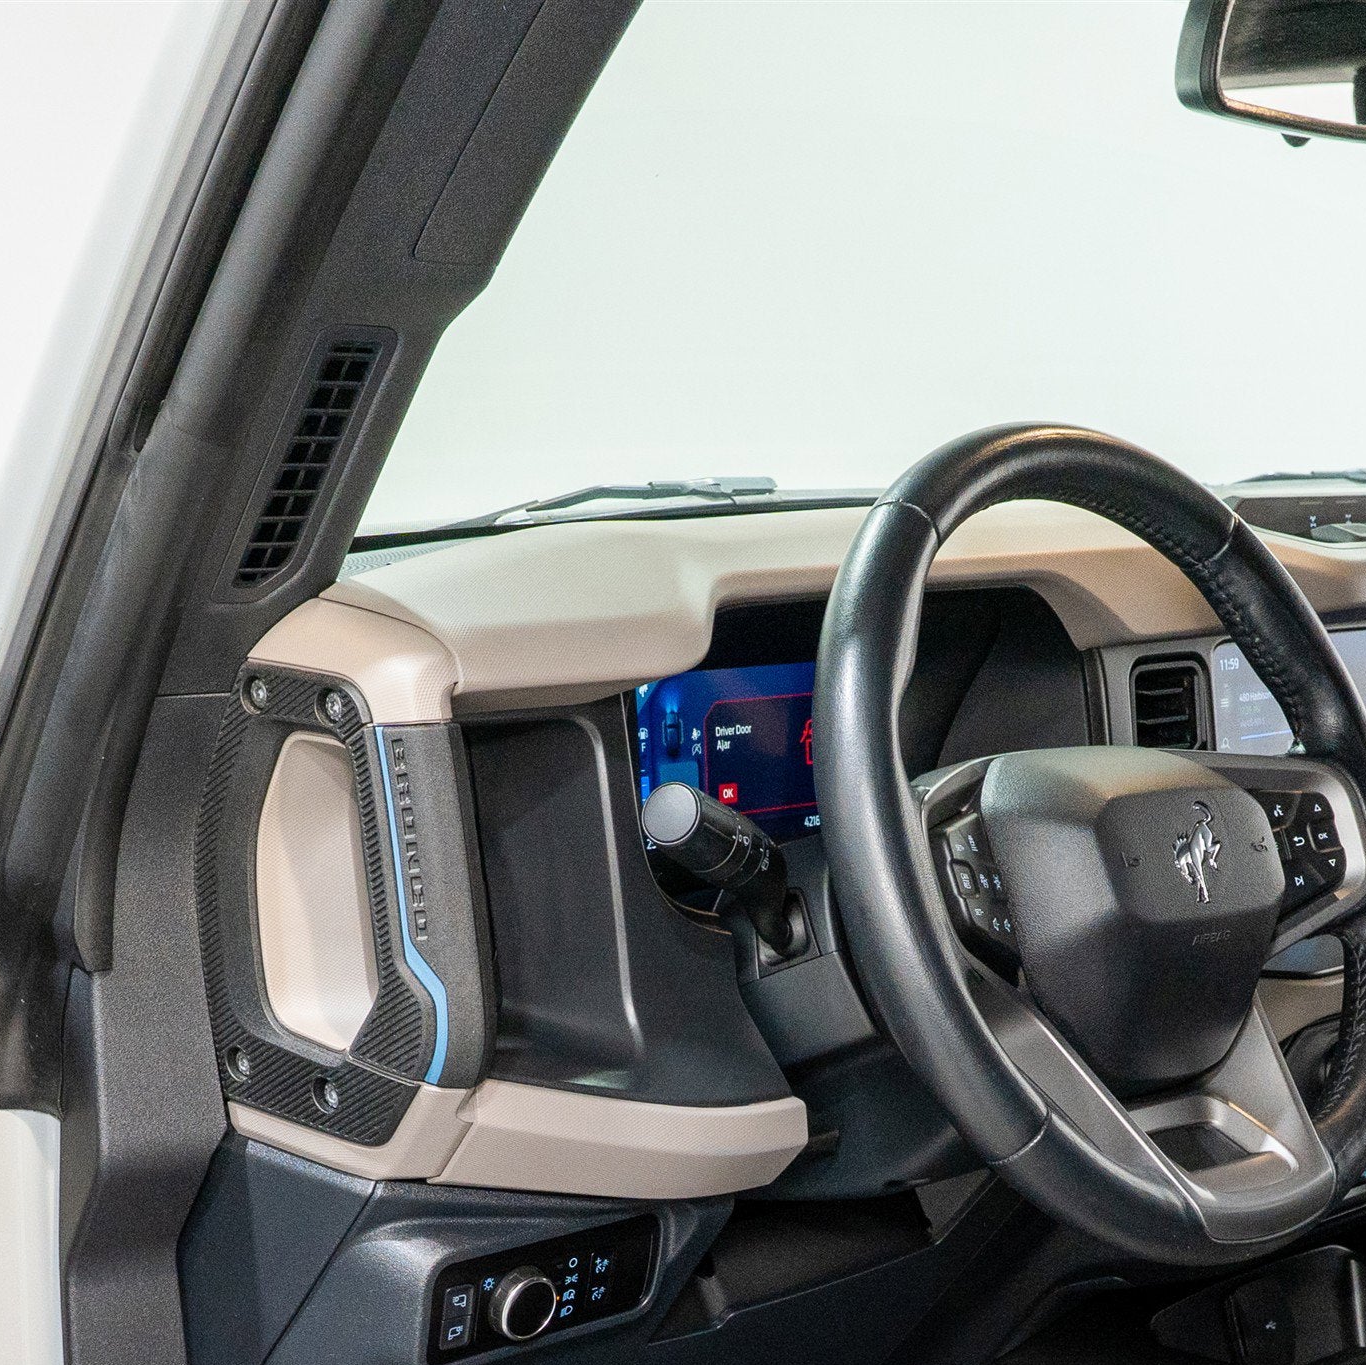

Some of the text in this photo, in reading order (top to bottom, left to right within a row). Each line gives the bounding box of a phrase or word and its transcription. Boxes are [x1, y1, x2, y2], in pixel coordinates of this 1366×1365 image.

[1220, 657, 1239, 671] 11:59
[715, 724, 752, 738] Driver Door
[641, 743, 646, 752] F
[716, 739, 731, 752] Ajar
[722, 787, 734, 799] OK
[391, 738, 428, 941] BRONCO
[1318, 832, 1328, 840] OK
